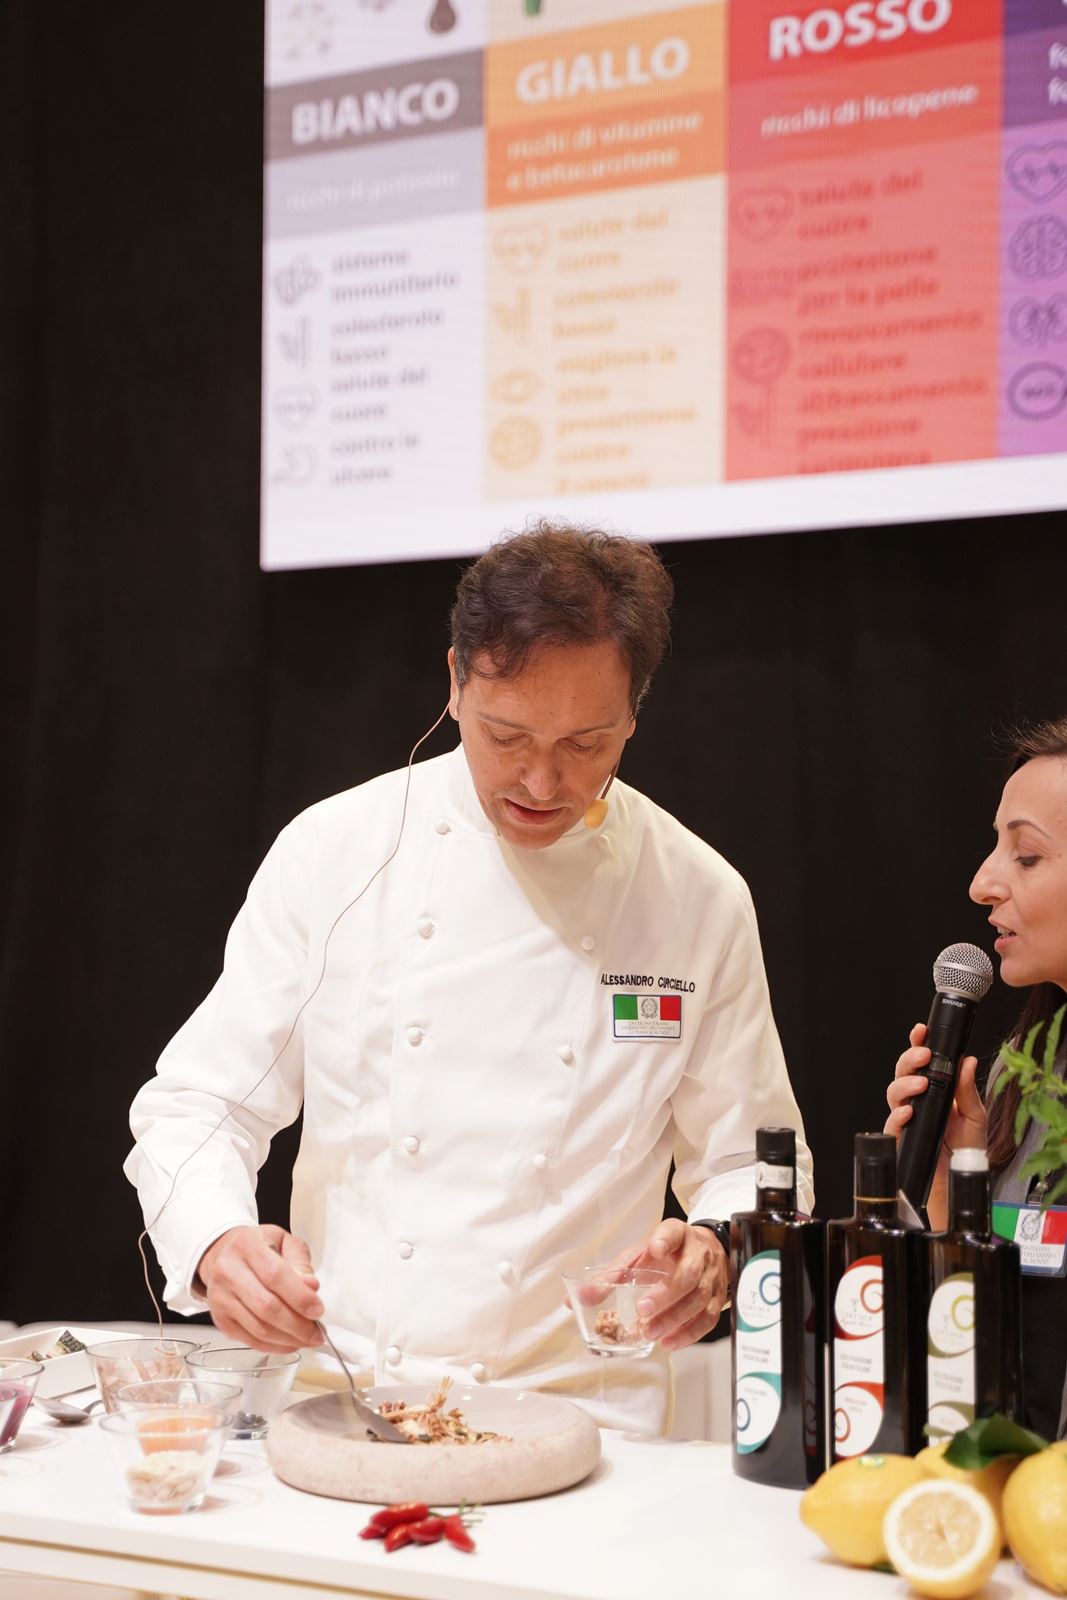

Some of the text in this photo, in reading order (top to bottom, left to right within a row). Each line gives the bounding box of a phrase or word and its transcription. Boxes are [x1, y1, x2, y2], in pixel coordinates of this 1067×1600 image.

[768, 0, 953, 62] ROSSO
[515, 37, 690, 103] GIALLO
[291, 79, 460, 145] BIANCO
[761, 84, 979, 138] ricchi di licopene
[600, 973, 696, 993] ALESSANDRO CIRCIELLO
[941, 998, 964, 1008] SHURE
